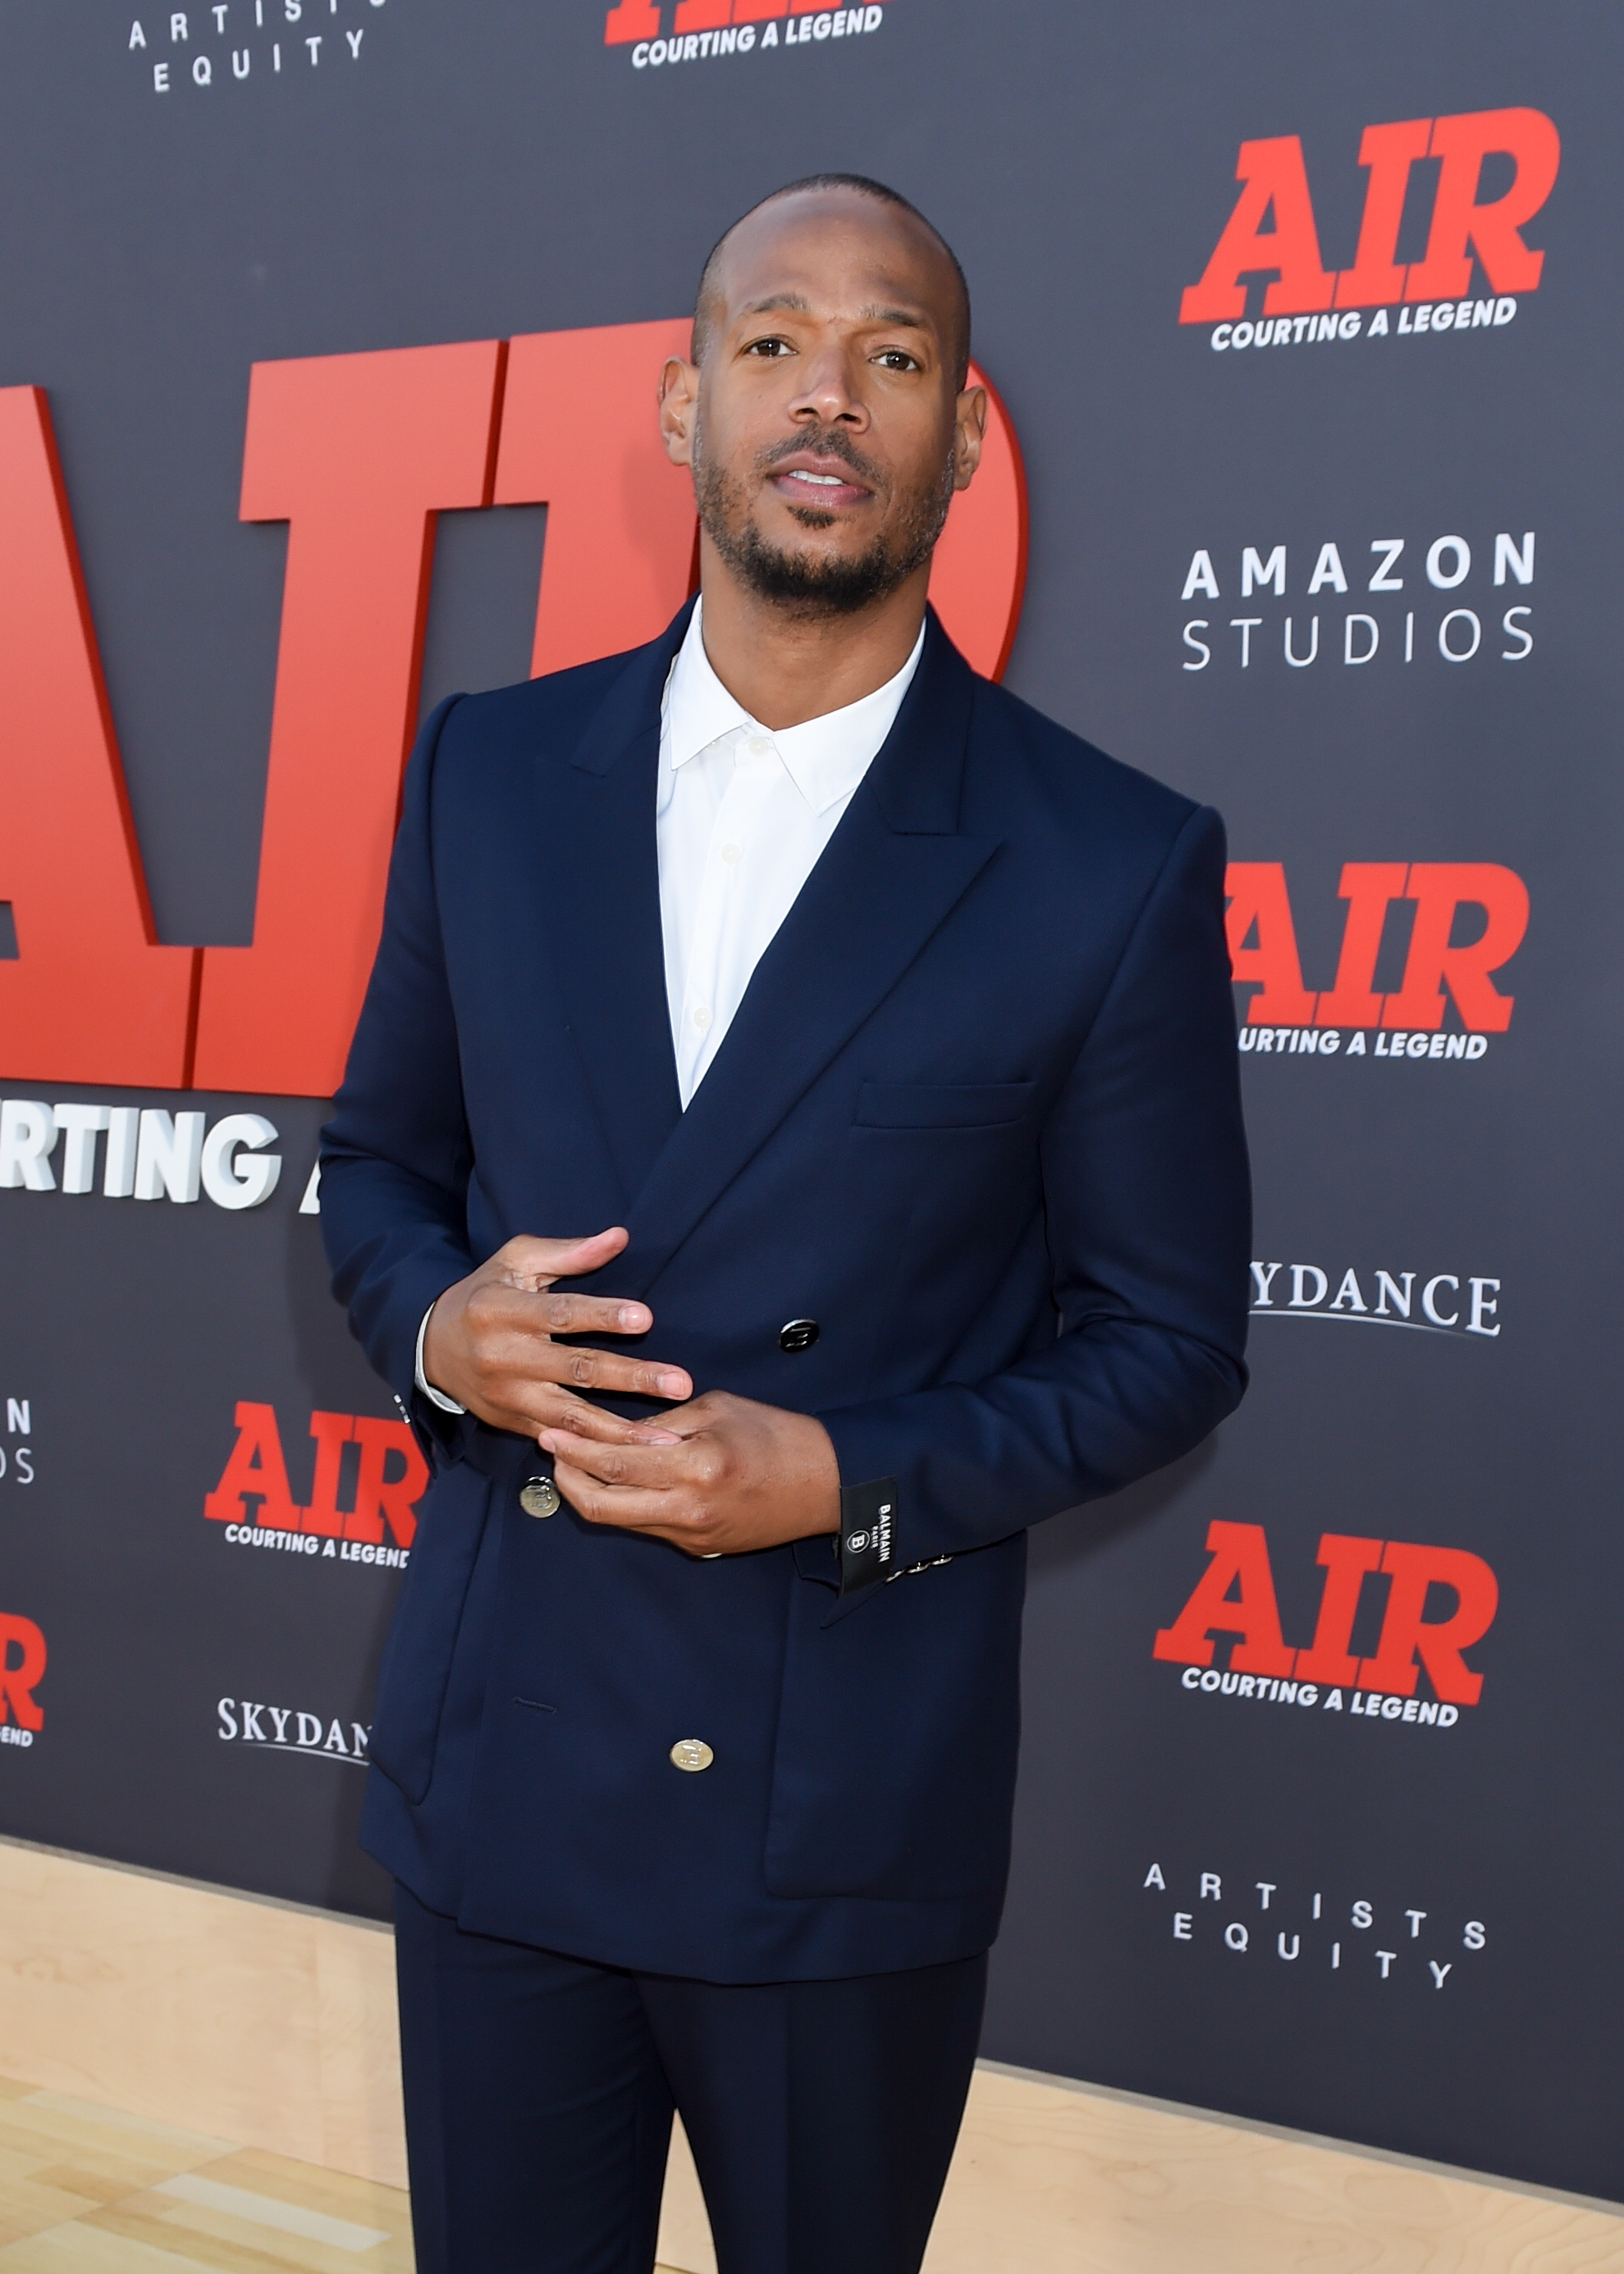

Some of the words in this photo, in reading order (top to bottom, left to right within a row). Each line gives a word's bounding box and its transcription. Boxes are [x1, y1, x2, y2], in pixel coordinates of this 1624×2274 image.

[129, 0, 386, 49] ARTIS
[632, 25, 756, 68] COURTING
[760, 21, 779, 48] A
[785, 5, 883, 44] LEGEND
[153, 29, 364, 92] EQUITY
[1178, 107, 1561, 325] AIR
[1210, 311, 1362, 351] COURTING
[1366, 309, 1389, 337] A
[1397, 297, 1517, 334] LEGEND
[1181, 531, 1535, 600] AMAZON
[1183, 606, 1534, 671] STUDIOS
[1224, 862, 1530, 1033] AIR
[1238, 1027, 1341, 1055] URTING
[1346, 1031, 1366, 1056] A
[1374, 1032, 1488, 1059] LEGEND
[0, 1098, 282, 1210] RTING
[1248, 1261, 1501, 1337] YDANCE
[204, 1401, 430, 1549] AIR
[225, 1524, 319, 1555] COURTING
[322, 1539, 336, 1558] A
[879, 1503, 891, 1563] BALMAIN
[1152, 1519, 1499, 1707] AIR
[217, 1697, 373, 1757] SKYDAN
[1182, 1667, 1319, 1707] COURTING
[1324, 1688, 1343, 1712] A
[1351, 1691, 1459, 1727] LEGEND
[0, 1725, 34, 1747] END
[1144, 1863, 1486, 1950] ARTISTS
[1173, 1912, 1452, 1989] EQUITY
